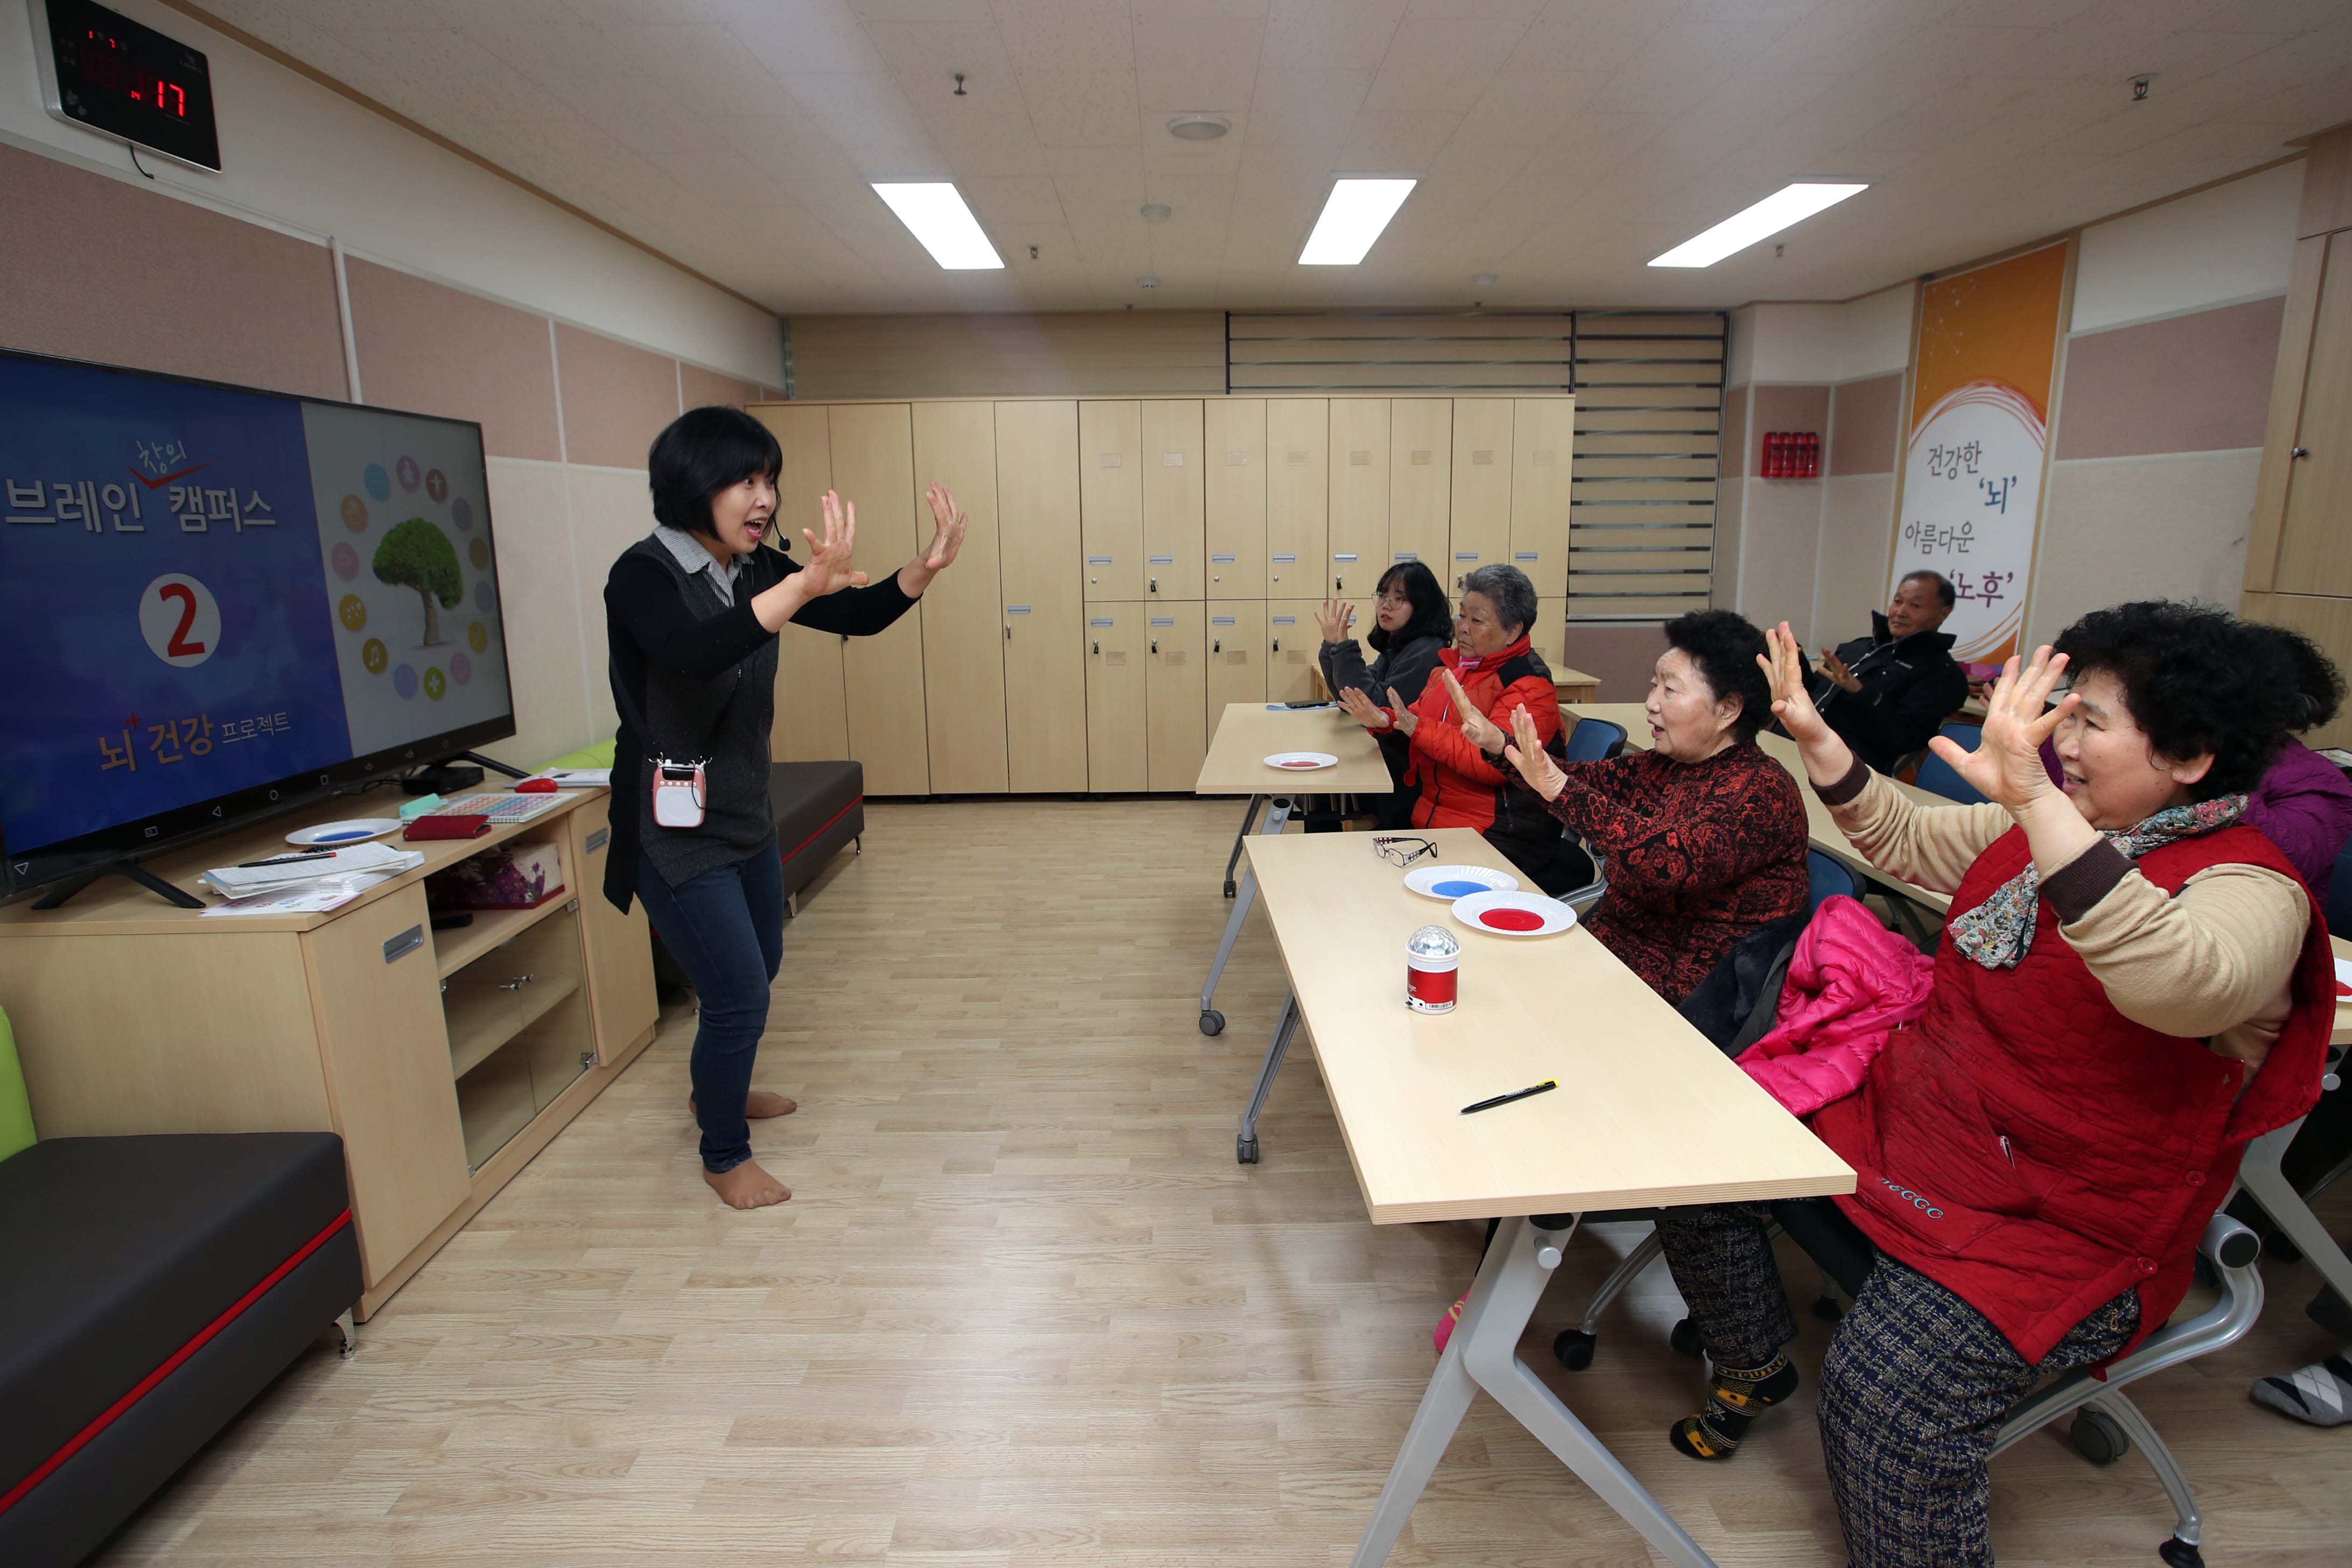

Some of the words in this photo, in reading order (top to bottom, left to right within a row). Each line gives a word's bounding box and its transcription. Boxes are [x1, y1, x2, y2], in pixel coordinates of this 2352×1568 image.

[158, 80, 185, 117] 17
[136, 439, 187, 474] 창의
[1927, 440, 1983, 480] 건강한
[5, 478, 145, 533] 브레인
[169, 485, 276, 533] 캠퍼스
[1905, 520, 1975, 555] 아름다운
[158, 582, 206, 657] 2
[99, 729, 137, 772] 뇌
[148, 714, 214, 764] 건강
[221, 712, 291, 744] 프로젝트
